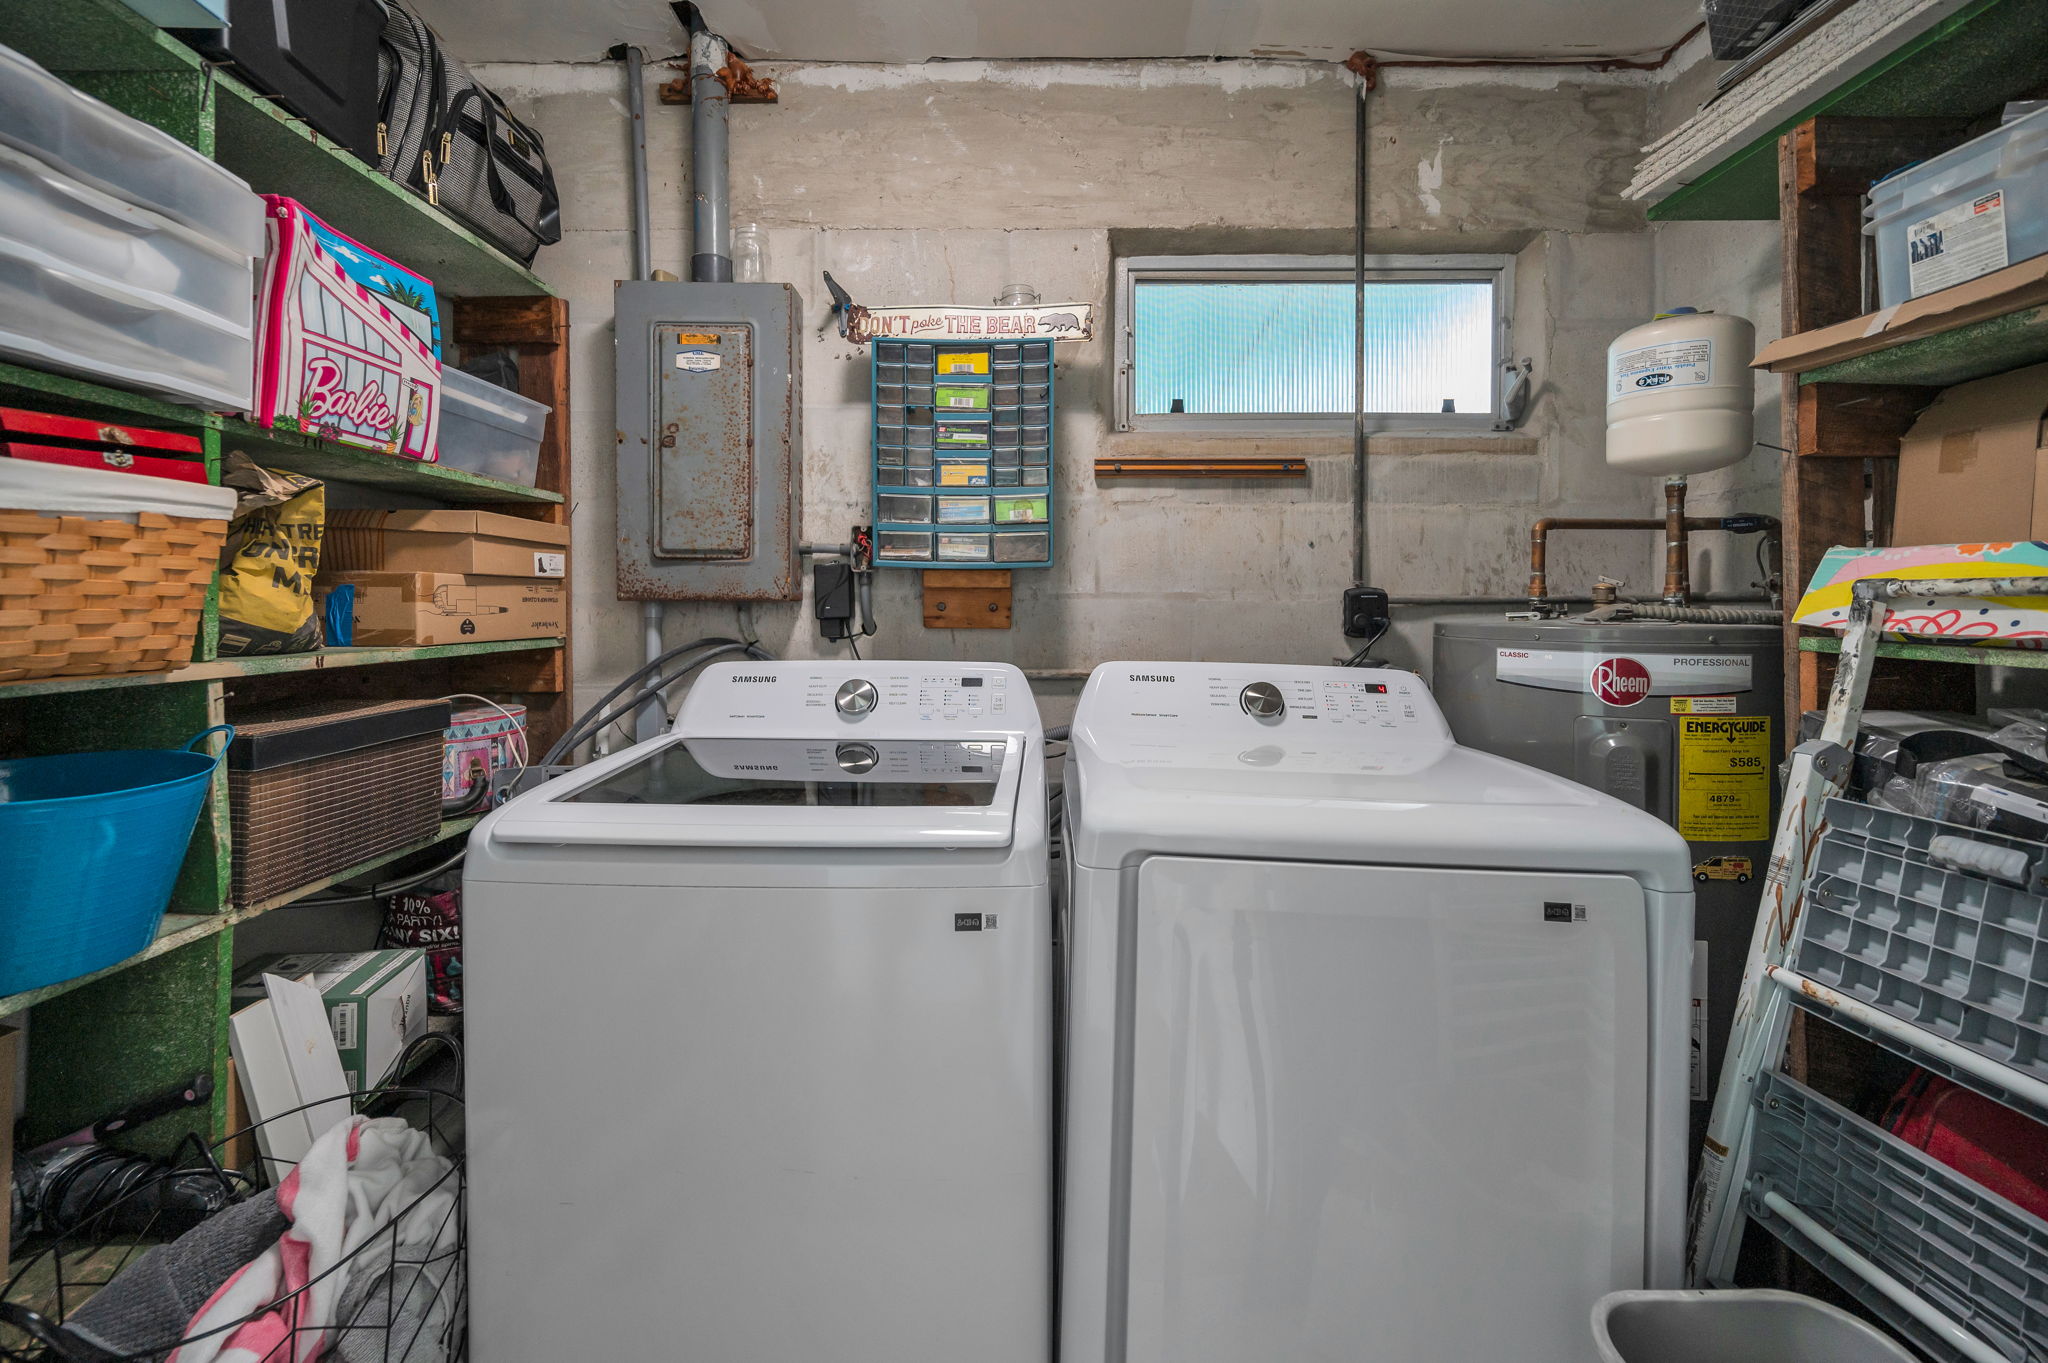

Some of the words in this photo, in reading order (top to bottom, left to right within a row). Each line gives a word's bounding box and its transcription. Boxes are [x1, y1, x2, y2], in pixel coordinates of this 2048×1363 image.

[858, 315, 911, 335] DON'T
[910, 317, 945, 335] poke
[944, 315, 982, 334] THE
[986, 315, 1037, 335] BEAR
[307, 357, 396, 431] Barbie
[1499, 651, 1529, 659] CLASSIC
[1673, 657, 1750, 667] PROFESSIONAL
[731, 675, 777, 683] SAMSUNG
[1129, 674, 1176, 683] SAMSUNG
[1597, 658, 1648, 699] Rheem
[1377, 685, 1386, 693] 4
[1686, 721, 1766, 734] ENERGYGUIDE
[1729, 757, 1761, 768] $585
[1709, 794, 1735, 803] 4879
[402, 897, 431, 914] 10%
[397, 913, 442, 927] PARTY!
[419, 925, 460, 943] SIX!
